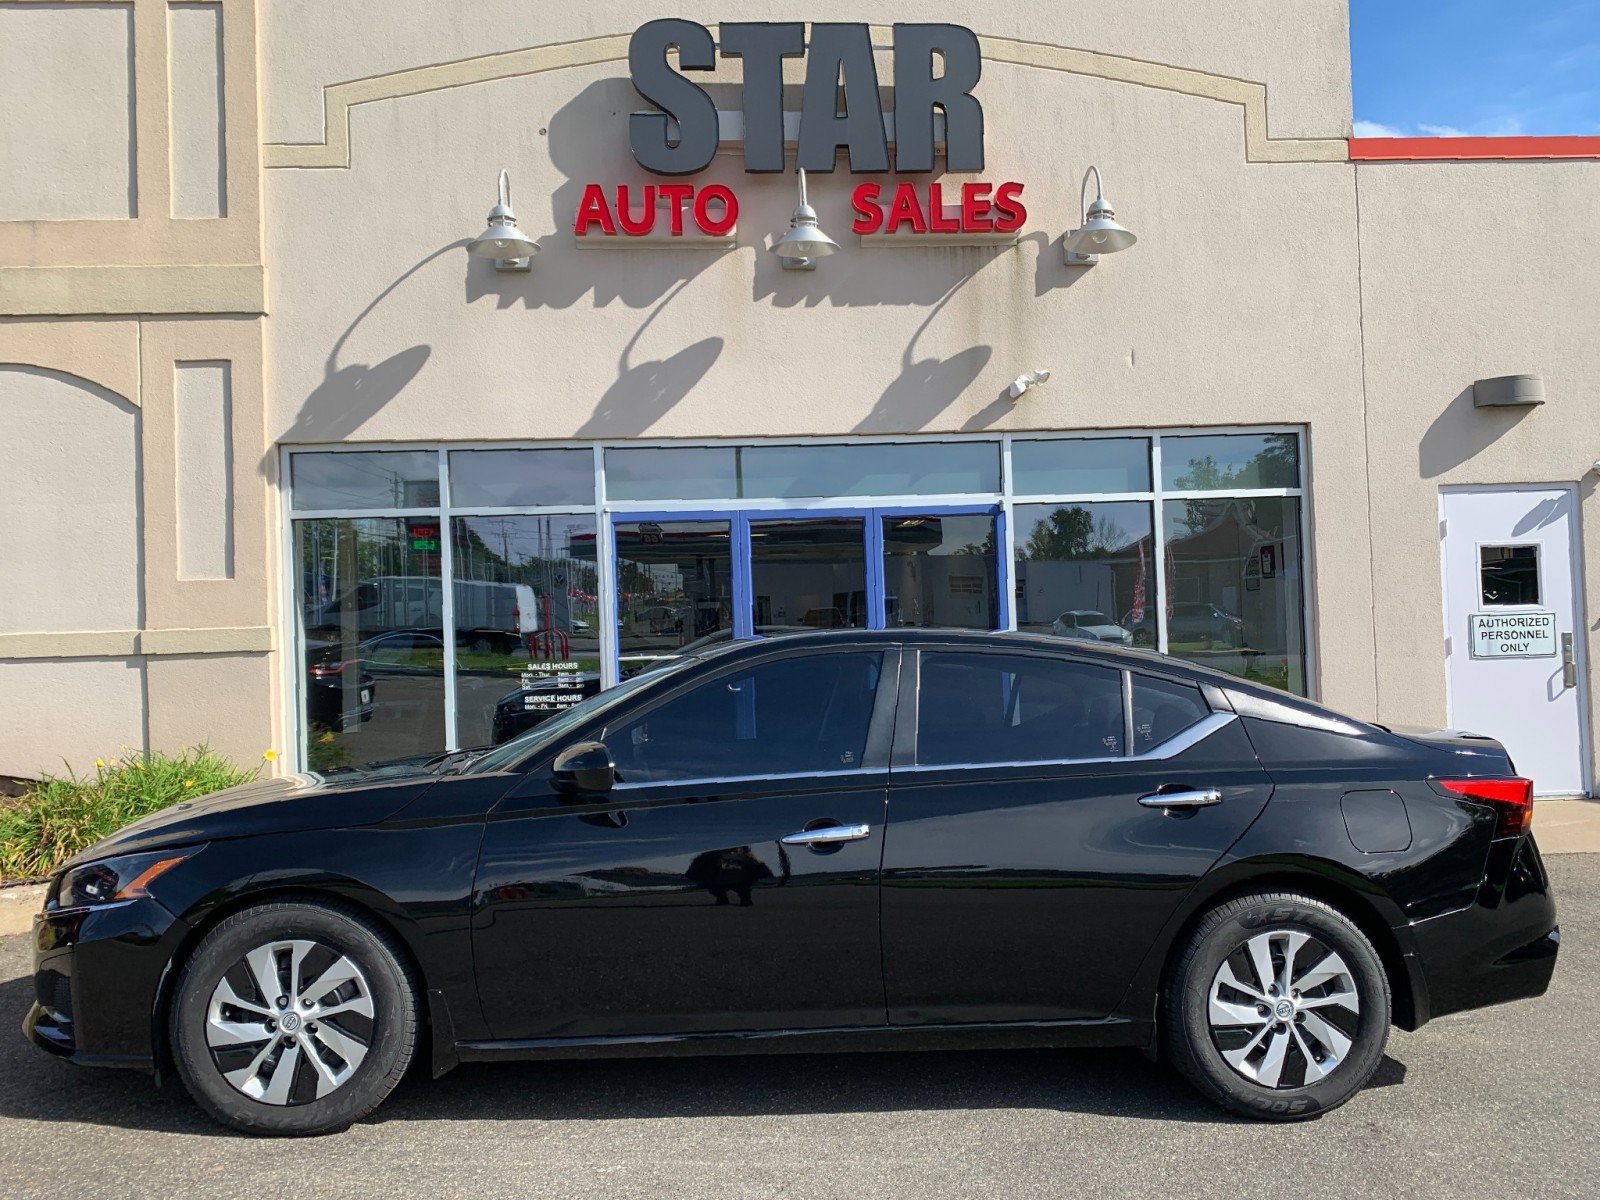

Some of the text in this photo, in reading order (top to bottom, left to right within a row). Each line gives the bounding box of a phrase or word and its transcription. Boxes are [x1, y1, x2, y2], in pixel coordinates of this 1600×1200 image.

[629, 18, 985, 176] STAR
[574, 181, 1027, 236] AUTO SALES
[1478, 617, 1550, 629] AUTHORIZED
[1481, 629, 1549, 641] PERSONNEL
[1500, 642, 1530, 653] ONLY
[527, 662, 578, 671] SALES HOURS
[556, 694, 583, 702] HOURS
